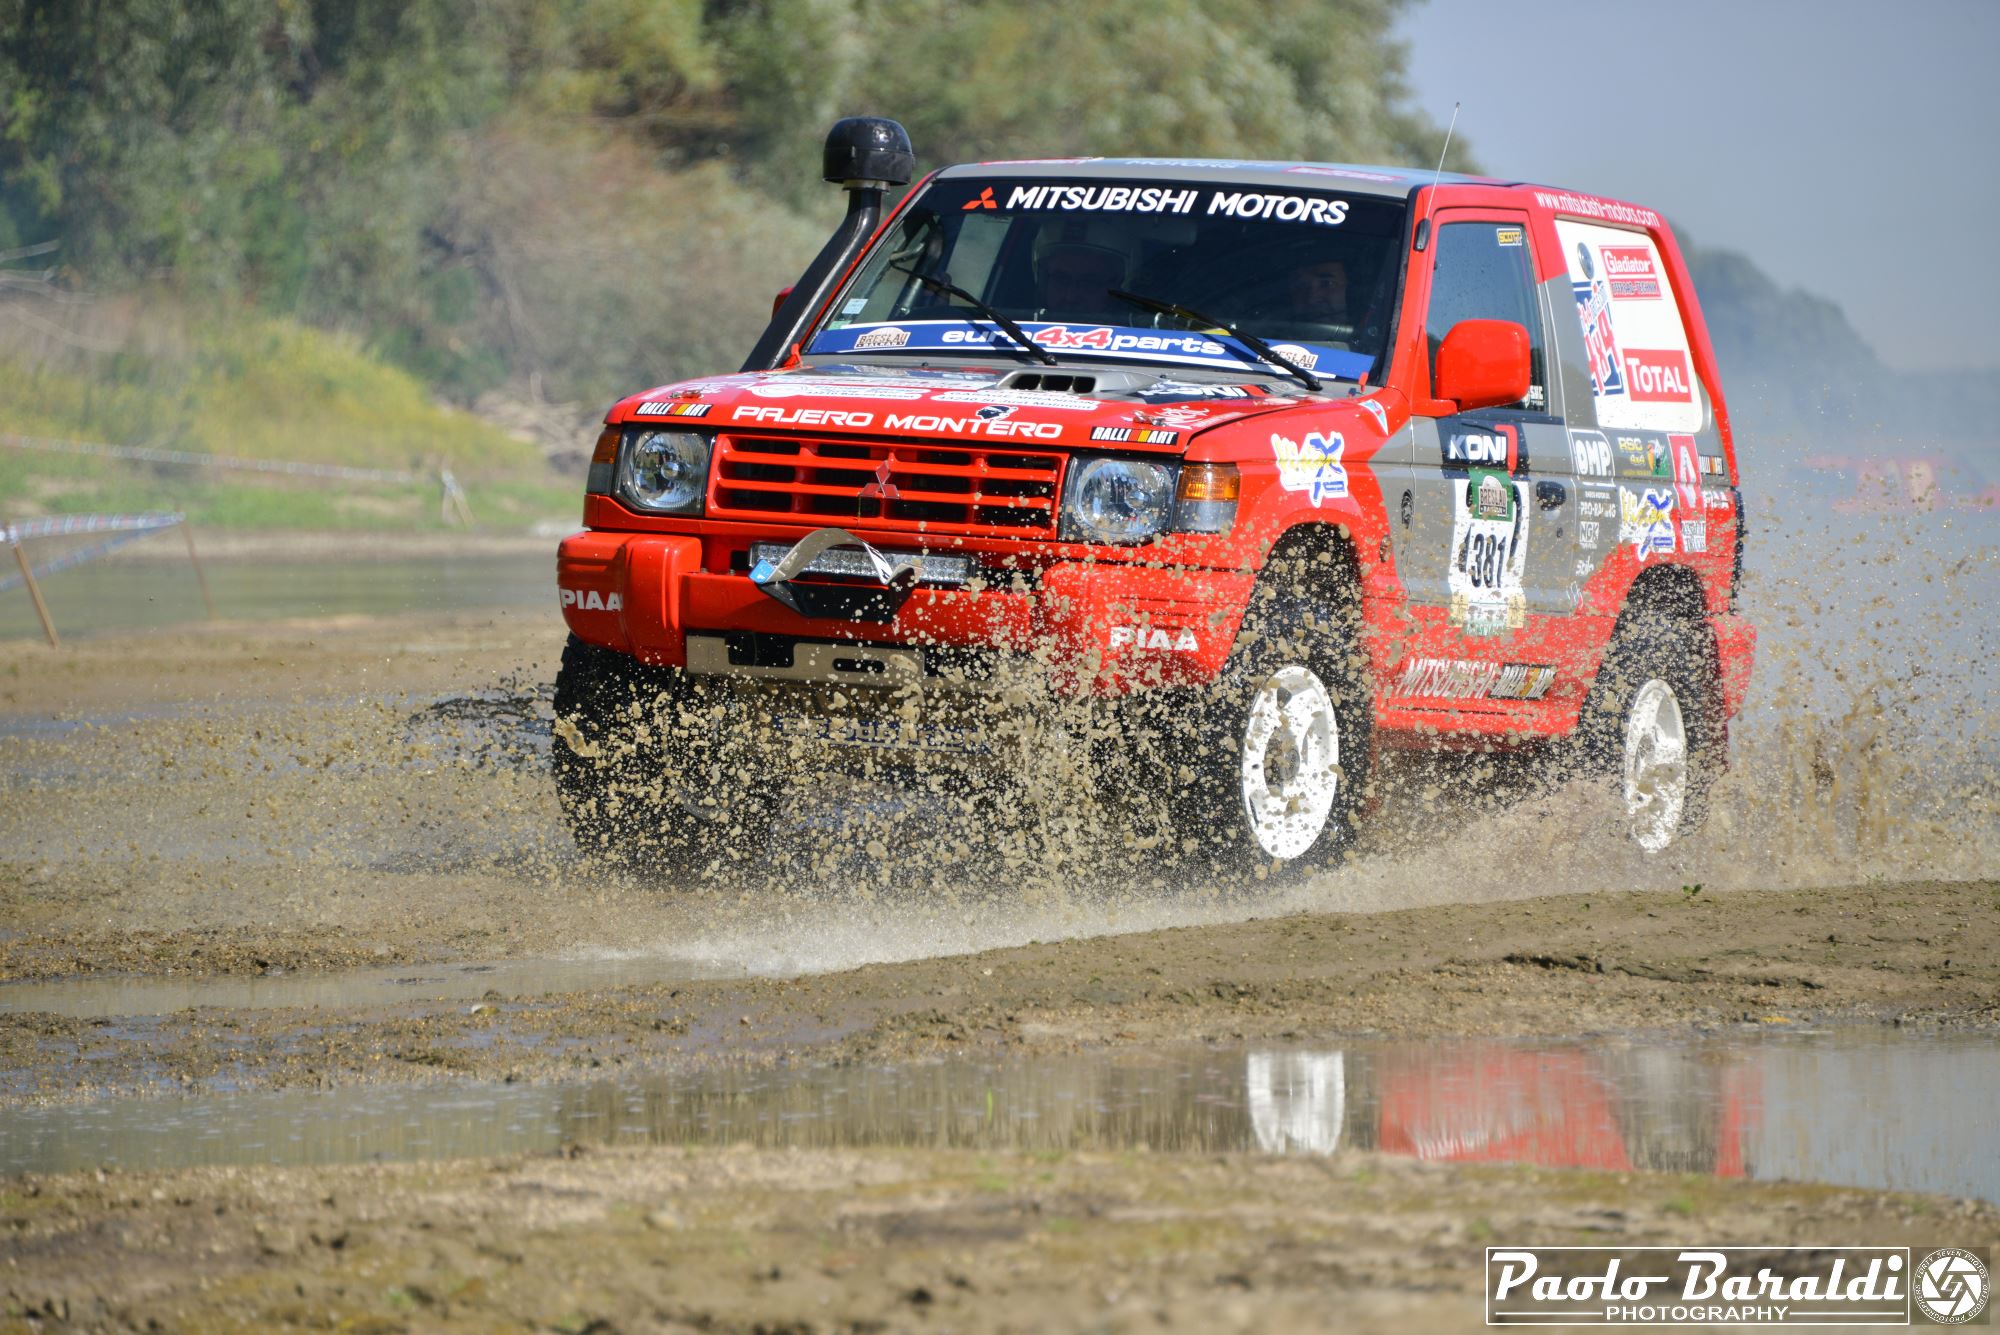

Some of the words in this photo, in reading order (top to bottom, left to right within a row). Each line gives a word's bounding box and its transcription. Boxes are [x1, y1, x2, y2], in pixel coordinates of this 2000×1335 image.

[1005, 185, 1199, 214] MITSUBISHI
[1206, 190, 1350, 225] MOTORS
[1534, 191, 1660, 227] www.mitsubishi-motors.com
[1603, 250, 1652, 273] Gladiator
[859, 333, 908, 345] BRESLAU
[1626, 357, 1689, 394] TOTAL
[637, 402, 669, 416] RALLI
[683, 404, 712, 417] ART
[732, 405, 874, 427] PAJERO
[884, 413, 1063, 438] MONTERO
[1091, 427, 1132, 442] RALLI
[1147, 431, 1177, 445] ART
[1449, 434, 1507, 461] KONI
[1575, 439, 1611, 476] OMP
[1480, 488, 1507, 506] BRESLAU
[1581, 522, 1600, 543] NGK
[560, 588, 623, 611] PIAA
[1110, 627, 1199, 651] PIAA
